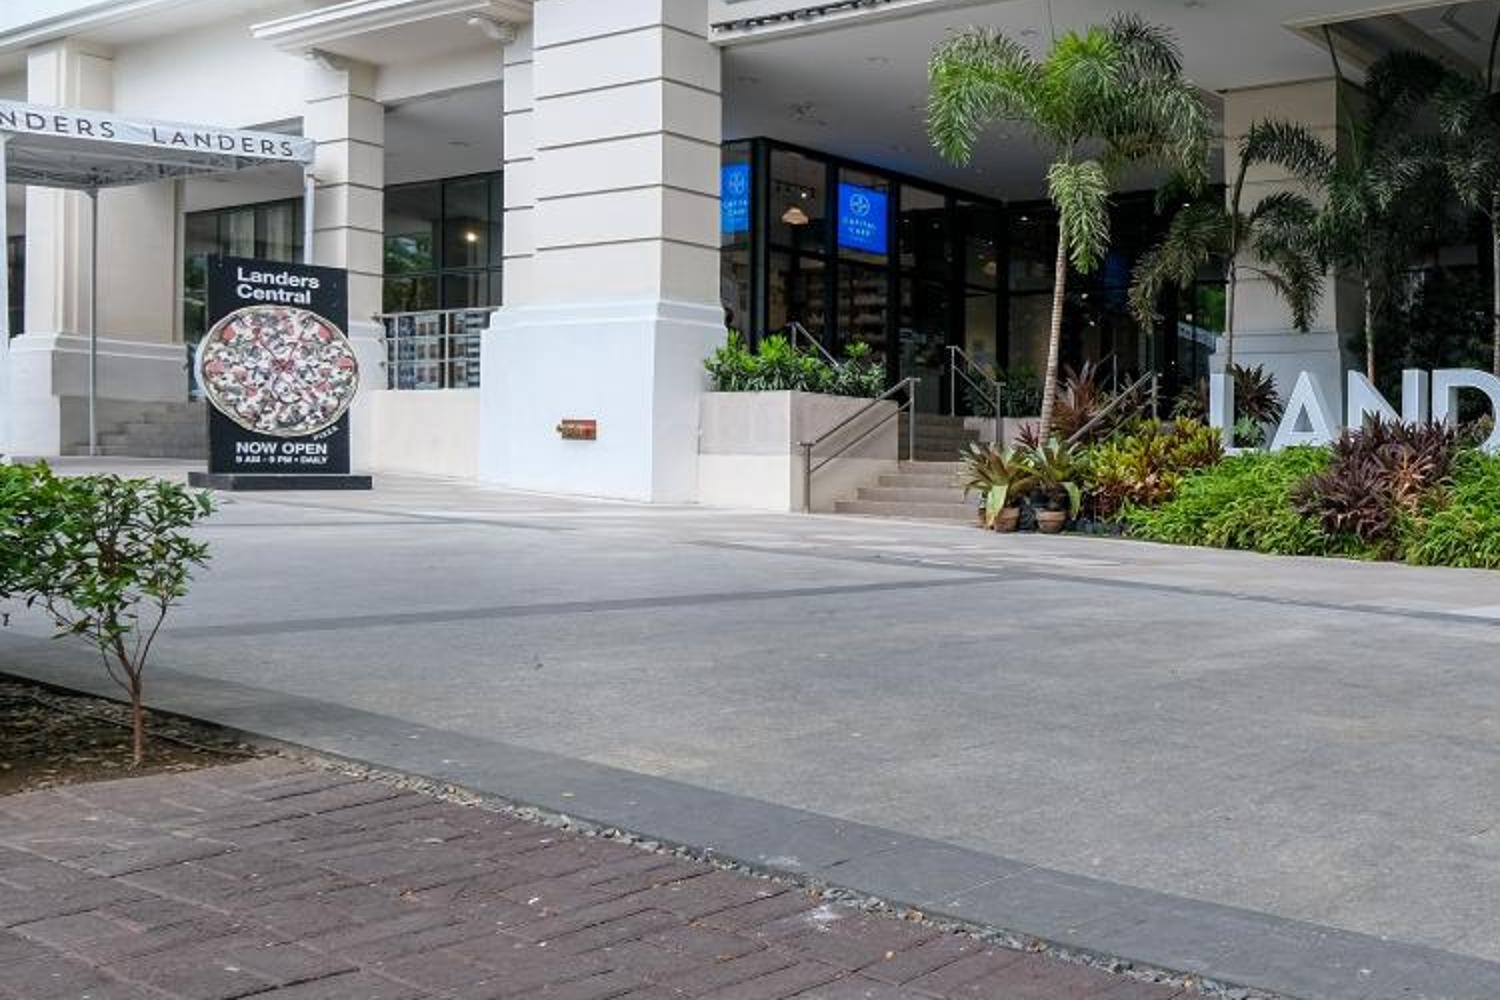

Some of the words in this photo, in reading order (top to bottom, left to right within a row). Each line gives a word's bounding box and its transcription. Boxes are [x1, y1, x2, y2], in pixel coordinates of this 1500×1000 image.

[151, 127, 293, 157] LANDERS
[237, 266, 320, 289] Landers
[236, 283, 311, 305] Central
[235, 442, 278, 455] NOW
[281, 442, 328, 455] OPEN
